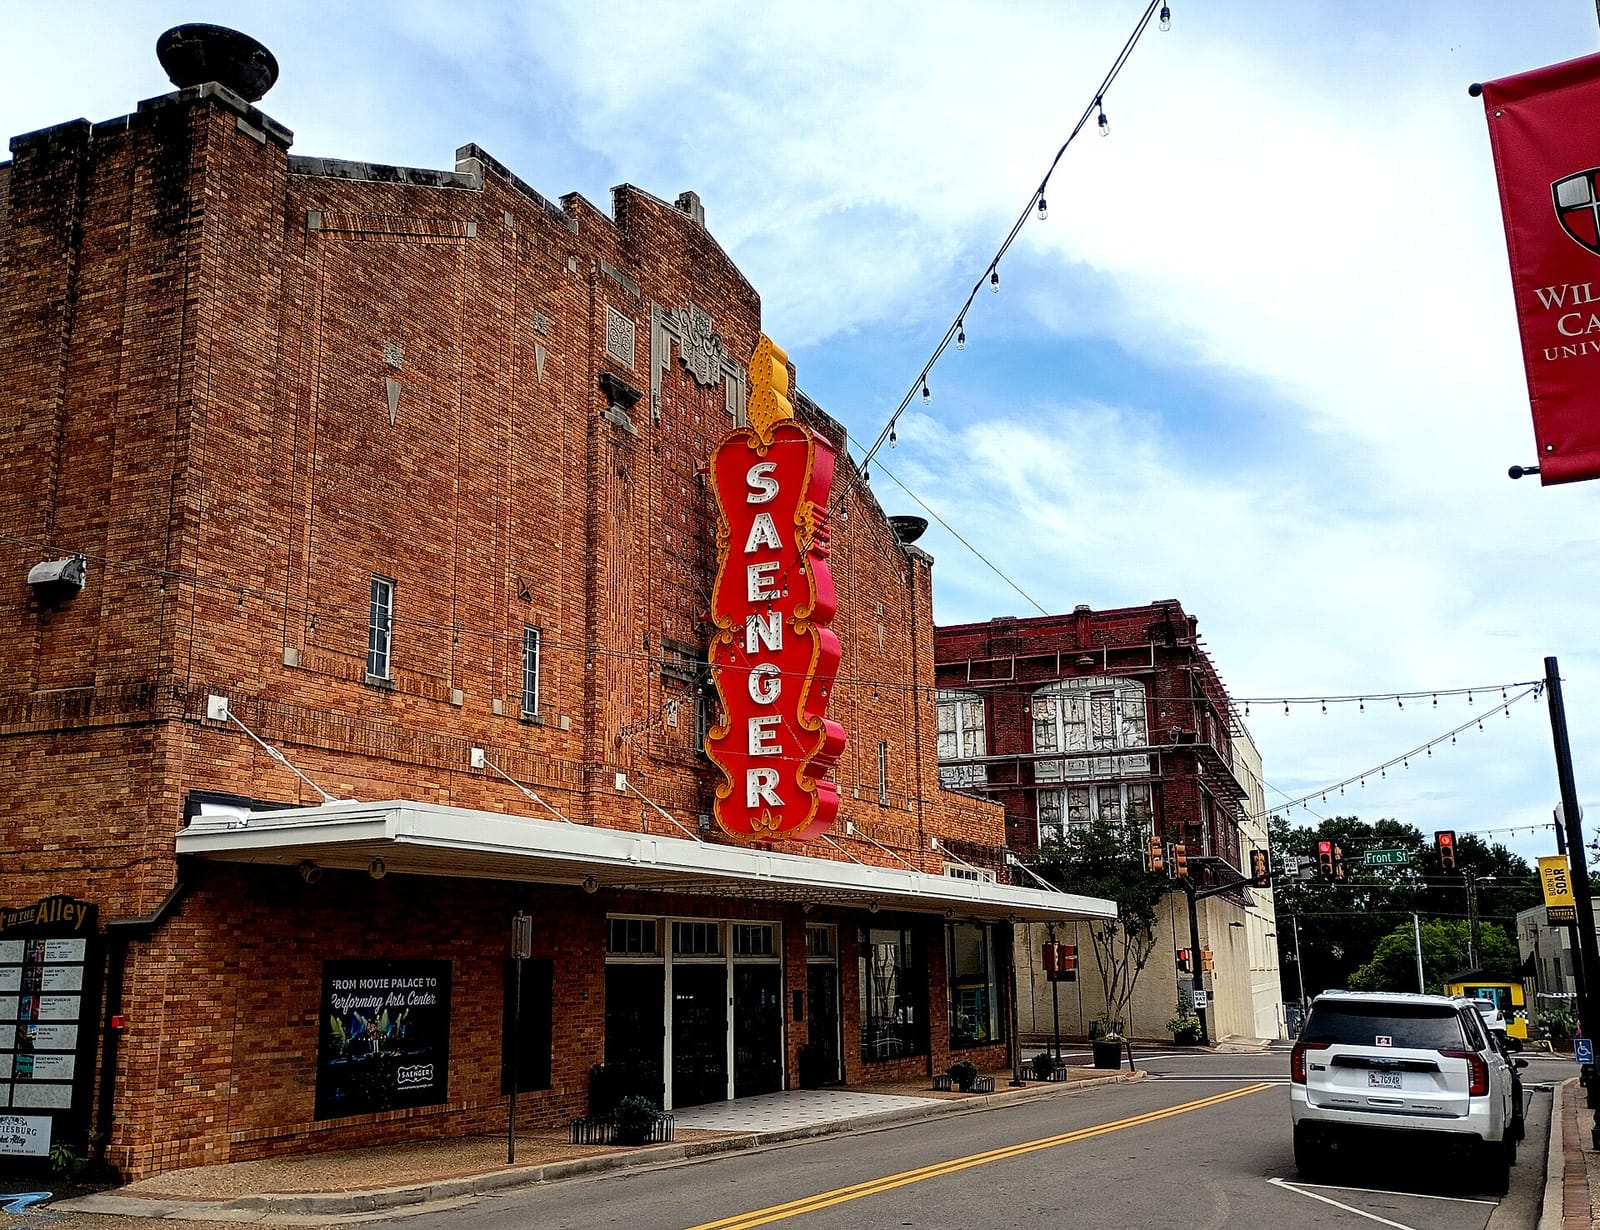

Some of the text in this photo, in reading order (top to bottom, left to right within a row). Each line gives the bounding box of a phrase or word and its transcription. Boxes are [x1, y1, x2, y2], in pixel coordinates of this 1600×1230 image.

[1533, 282, 1600, 310] WIL
[743, 461, 786, 809] SAENGER
[1366, 851, 1407, 864] Front St
[1545, 868, 1553, 876] TO
[1553, 868, 1568, 895] SOAR
[8, 913, 17, 923] IN
[19, 909, 36, 921] THE
[35, 899, 87, 930] Alley
[359, 978, 389, 989] MOVIE
[391, 978, 424, 988] PALACE
[425, 977, 437, 987] TO
[385, 991, 405, 1006] Arts
[407, 990, 436, 1006] Center
[401, 1069, 430, 1079] SAENGER
